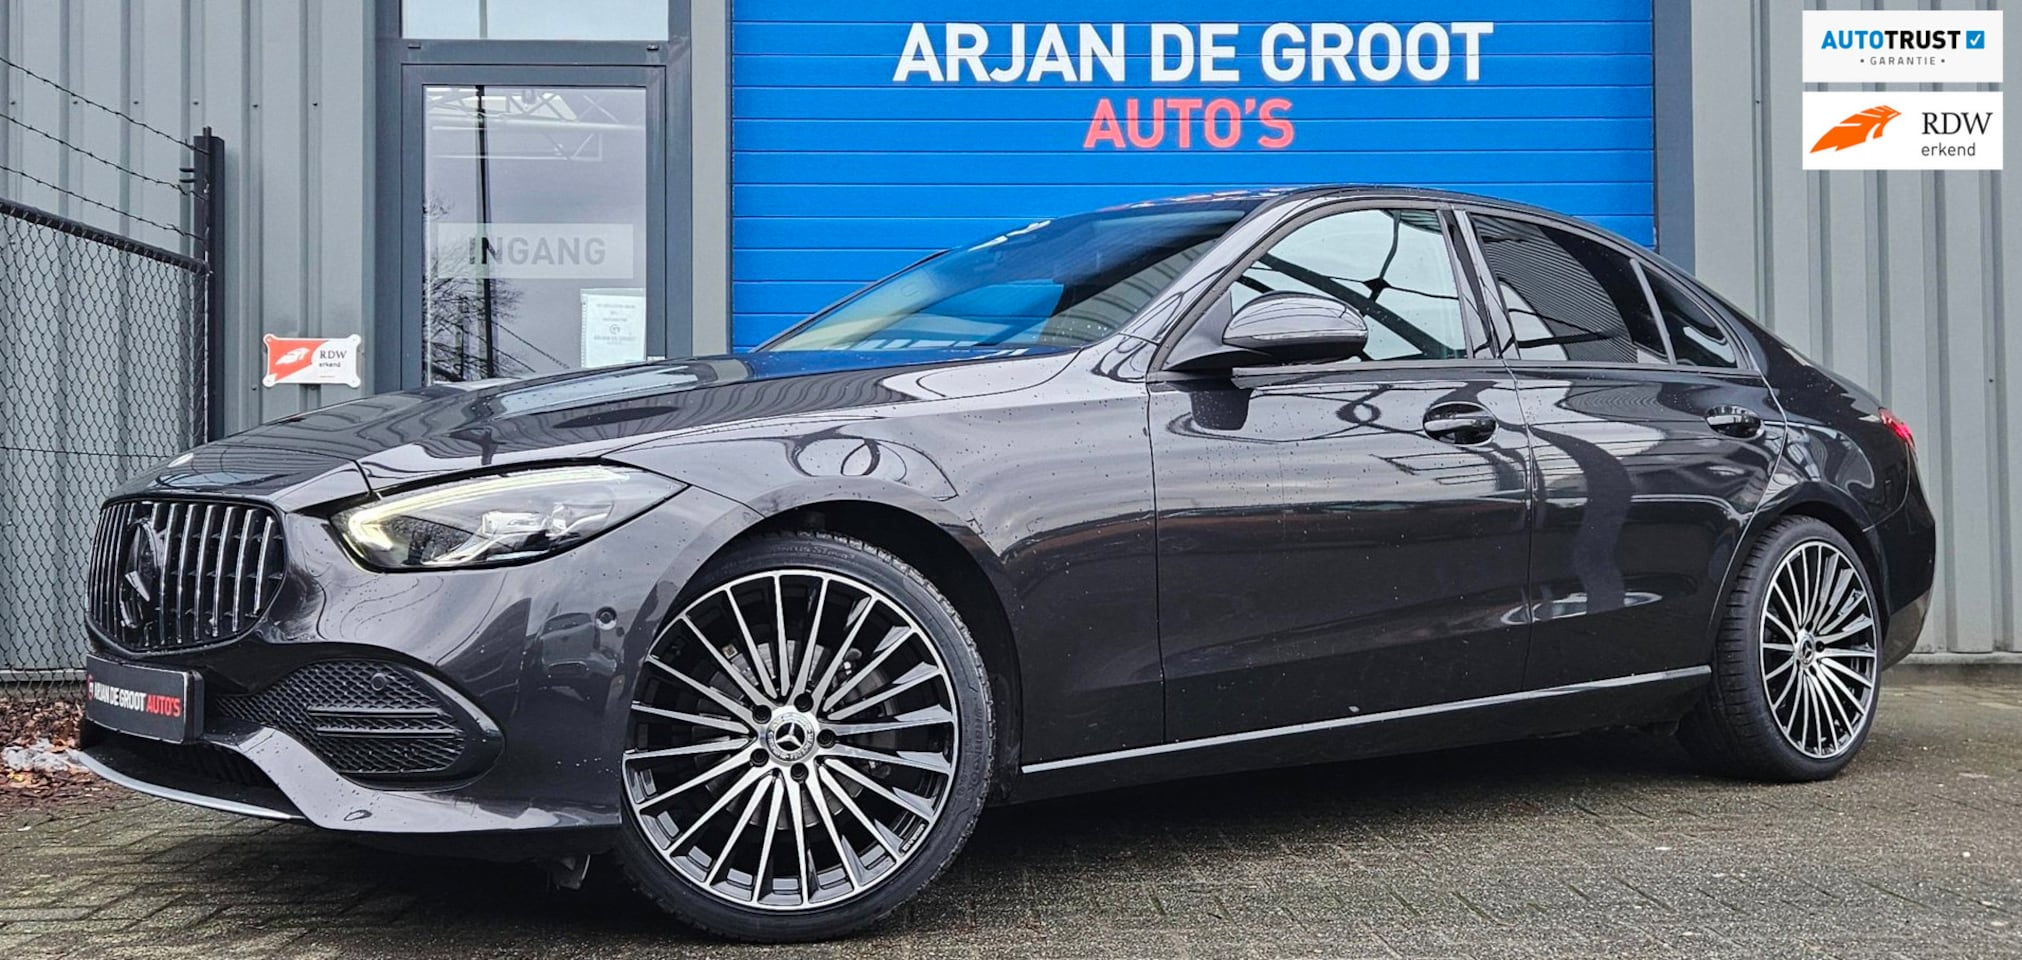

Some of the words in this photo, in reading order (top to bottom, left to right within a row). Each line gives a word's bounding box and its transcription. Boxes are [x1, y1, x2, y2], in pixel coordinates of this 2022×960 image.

[893, 22, 1125, 83] ARJAN
[1151, 22, 1240, 82] DE
[1261, 22, 1495, 82] GROOT
[1084, 98, 1295, 149] AUTO'S
[469, 236, 606, 265] INGANG
[320, 350, 347, 359] RDW
[119, 689, 147, 712] GROOT
[146, 694, 181, 718] AUTO'S
